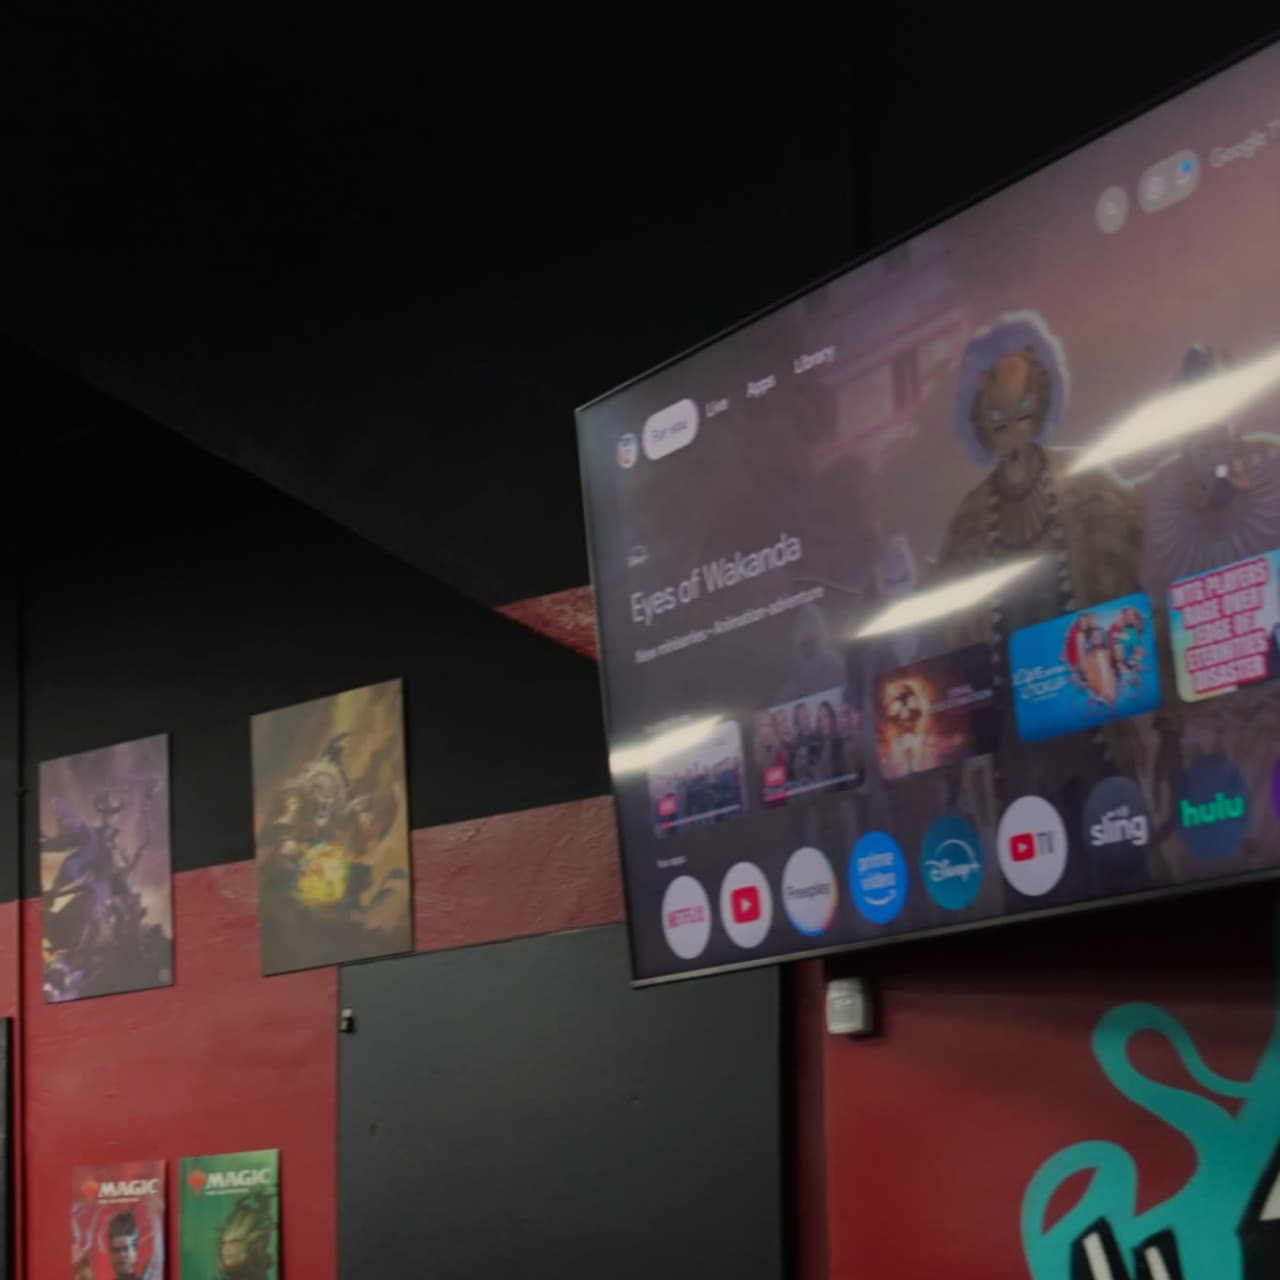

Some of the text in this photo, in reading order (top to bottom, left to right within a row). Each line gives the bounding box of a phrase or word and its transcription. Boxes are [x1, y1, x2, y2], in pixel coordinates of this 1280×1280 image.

[629, 533, 804, 627] Eyes of Wakanda
[1205, 558, 1270, 600] PLAYERS
[1180, 791, 1245, 828] hulu
[1090, 814, 1149, 847] sling
[858, 851, 895, 875] prime
[861, 872, 896, 891] video
[97, 1178, 160, 1198] MAGIC
[205, 1168, 272, 1189] MAGIC
